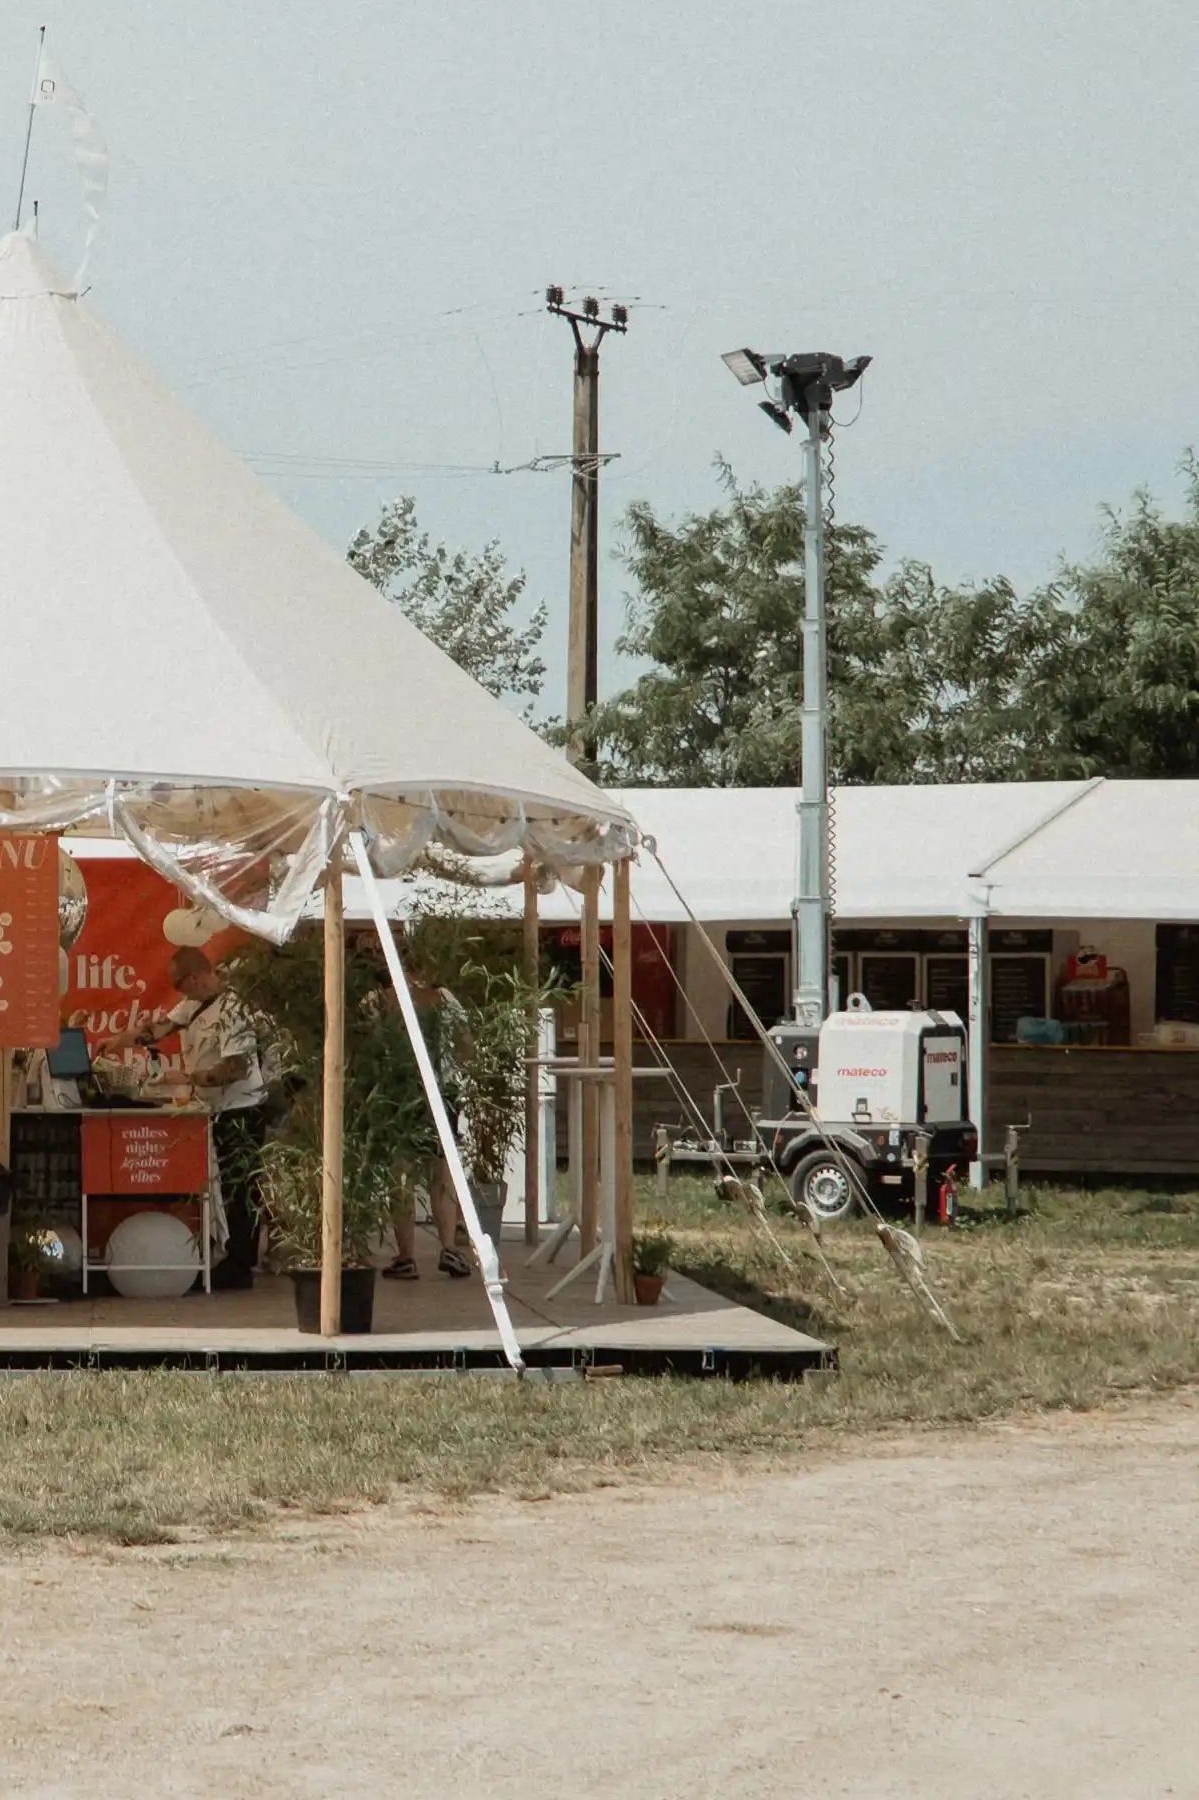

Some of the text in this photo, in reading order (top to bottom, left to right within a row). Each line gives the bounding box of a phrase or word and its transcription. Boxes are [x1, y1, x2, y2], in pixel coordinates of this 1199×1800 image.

[76, 954, 146, 993] life,
[926, 1051, 958, 1064] mateco
[837, 1066, 887, 1077] mateco
[122, 1126, 169, 1138] endless
